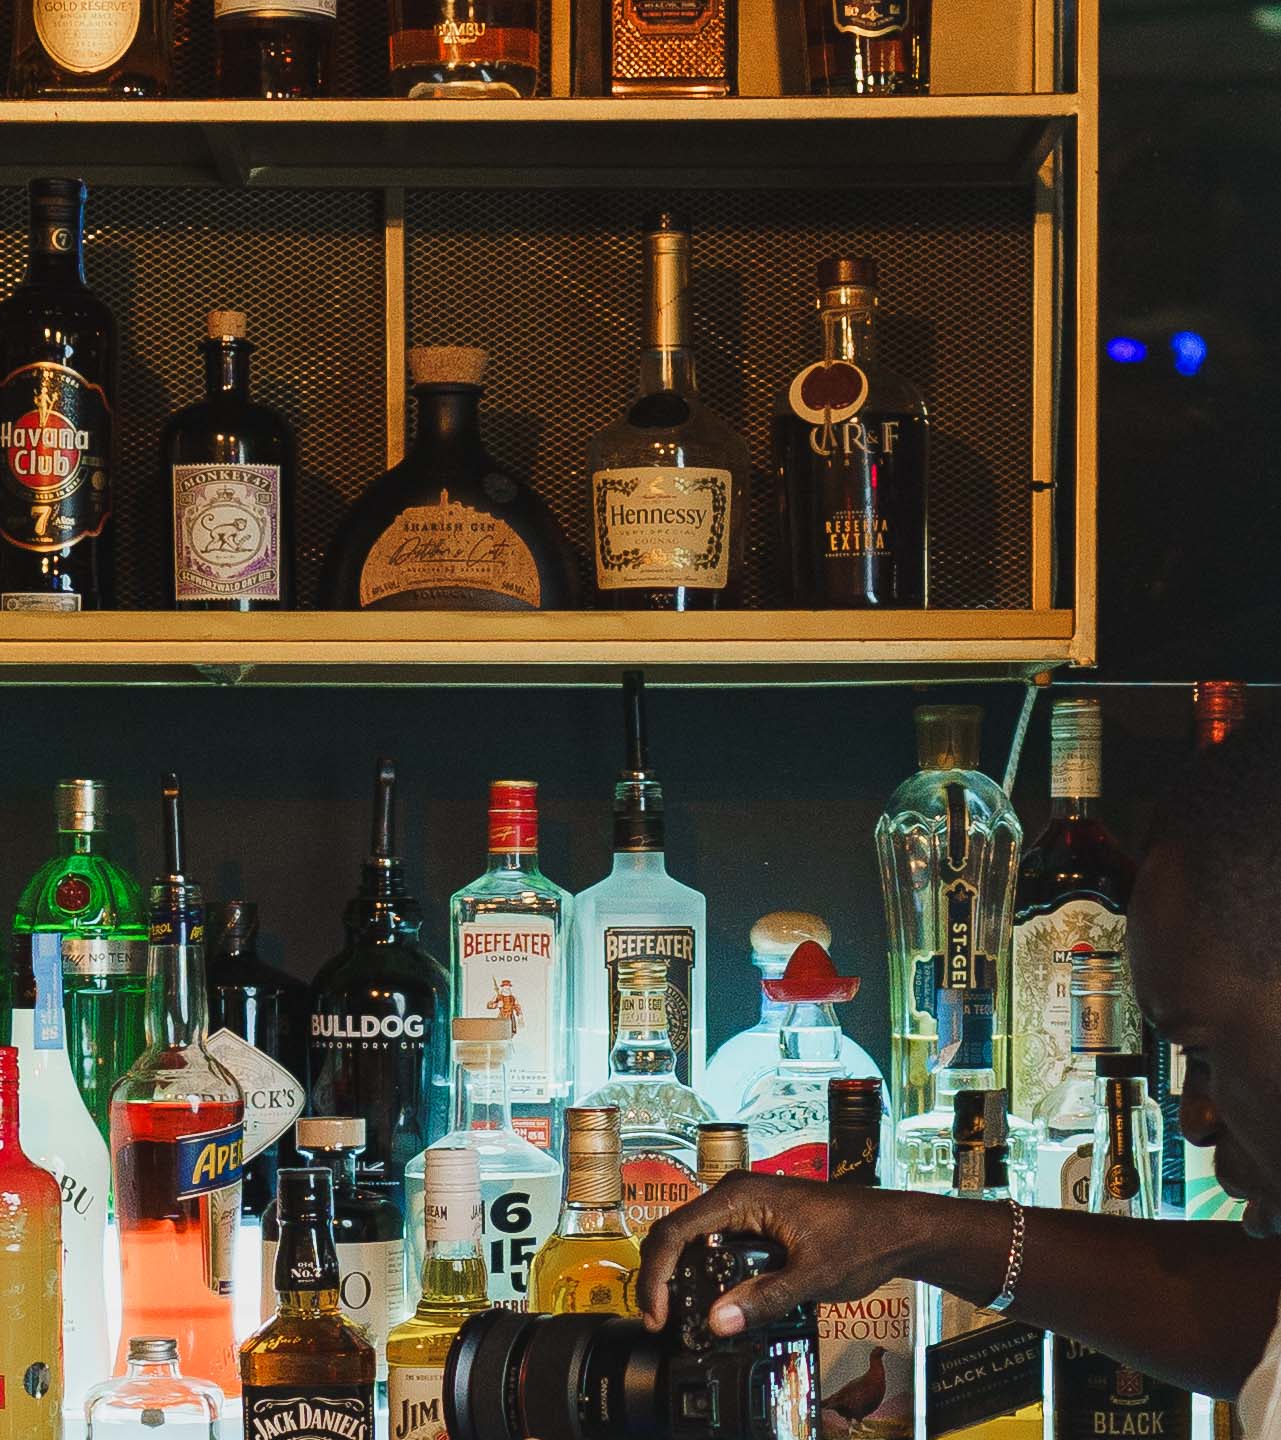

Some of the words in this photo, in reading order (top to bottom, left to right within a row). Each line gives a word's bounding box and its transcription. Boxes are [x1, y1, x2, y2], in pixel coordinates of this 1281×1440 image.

[43, 2, 78, 13] GOLD
[81, 1, 128, 13] RESERVE
[0, 420, 90, 451] Havana
[14, 449, 71, 478] Club
[184, 469, 250, 490] MONKEY
[252, 473, 272, 491] 47
[30, 504, 54, 537] 7
[402, 522, 463, 533] SHARISH
[469, 522, 496, 533] GIN
[610, 504, 707, 529] Hennessy
[824, 520, 889, 533] RESERVA
[829, 533, 886, 551] EXTRA
[241, 576, 258, 590] DRY
[107, 952, 133, 964] TEN
[462, 932, 552, 960] BEEFEATER
[607, 935, 694, 962] BEEFEATER
[310, 1013, 425, 1038] BULLDOG
[362, 1041, 388, 1049] DRY
[400, 1041, 426, 1049] GIN
[289, 1267, 322, 1279] No.7
[816, 1296, 910, 1320] FAMOUS
[816, 1319, 910, 1341] GROUSE
[939, 1348, 989, 1374] JOHNNIE
[988, 1332, 1040, 1357] WALKER
[933, 1367, 988, 1393] BLACK
[989, 1349, 1038, 1373] LABE
[395, 1397, 440, 1440] JIM
[1093, 1410, 1165, 1437] BLACK
